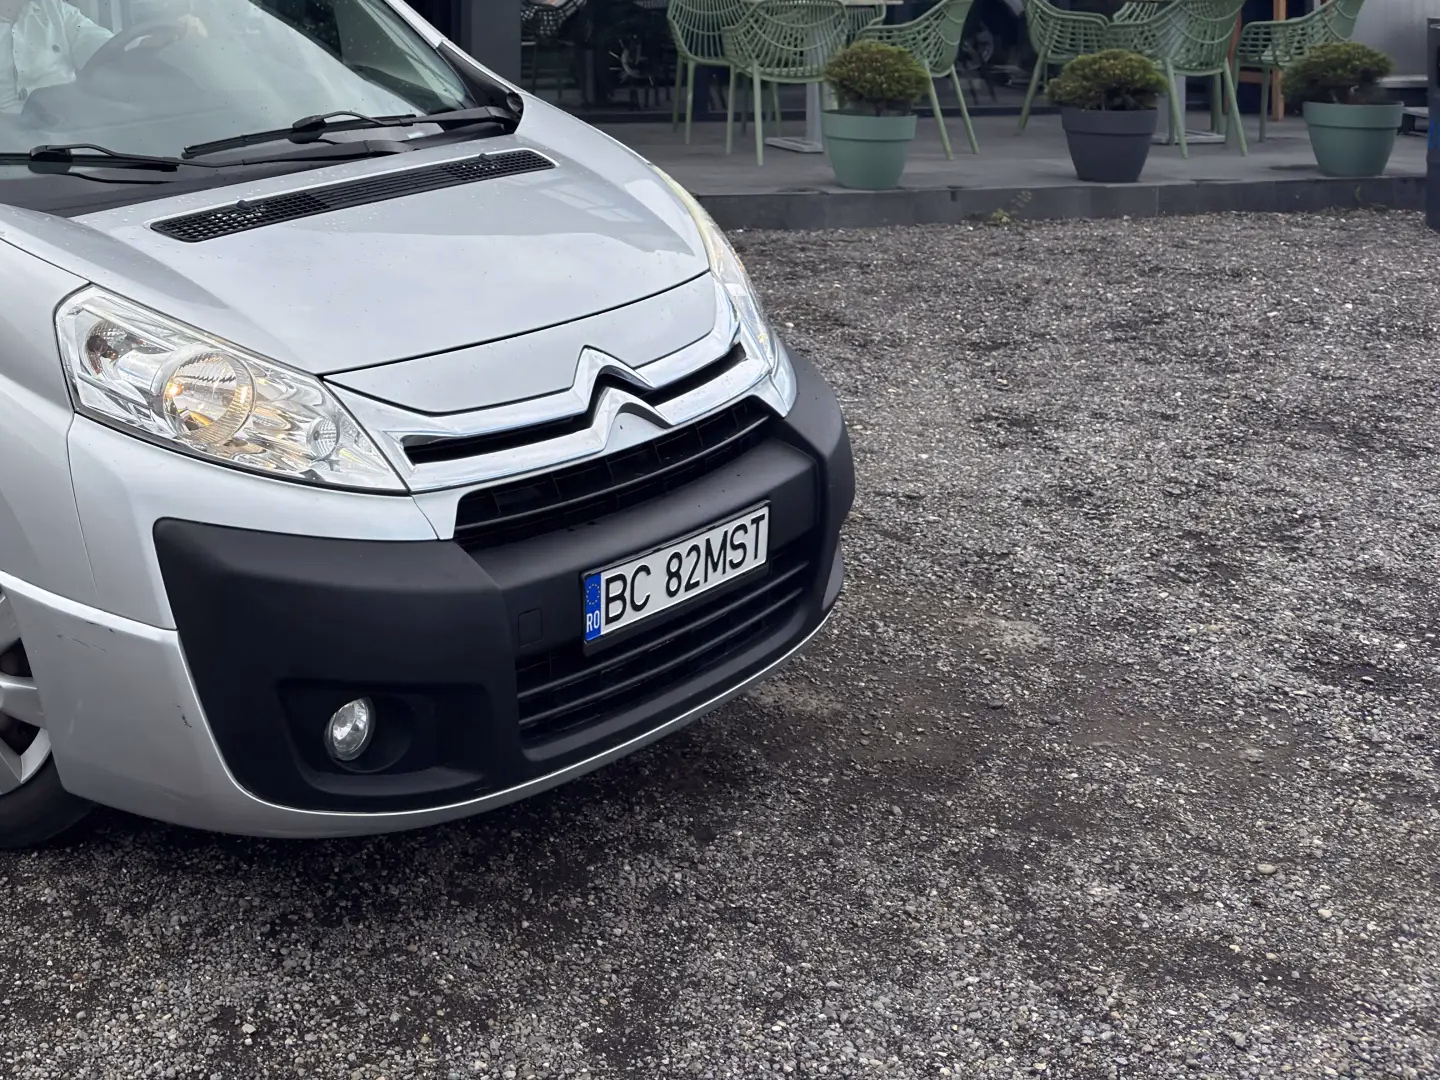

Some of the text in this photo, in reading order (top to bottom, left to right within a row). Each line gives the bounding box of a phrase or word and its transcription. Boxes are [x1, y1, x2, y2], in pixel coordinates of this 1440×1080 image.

[604, 513, 766, 626] BC 82MST
[586, 610, 600, 633] RO
